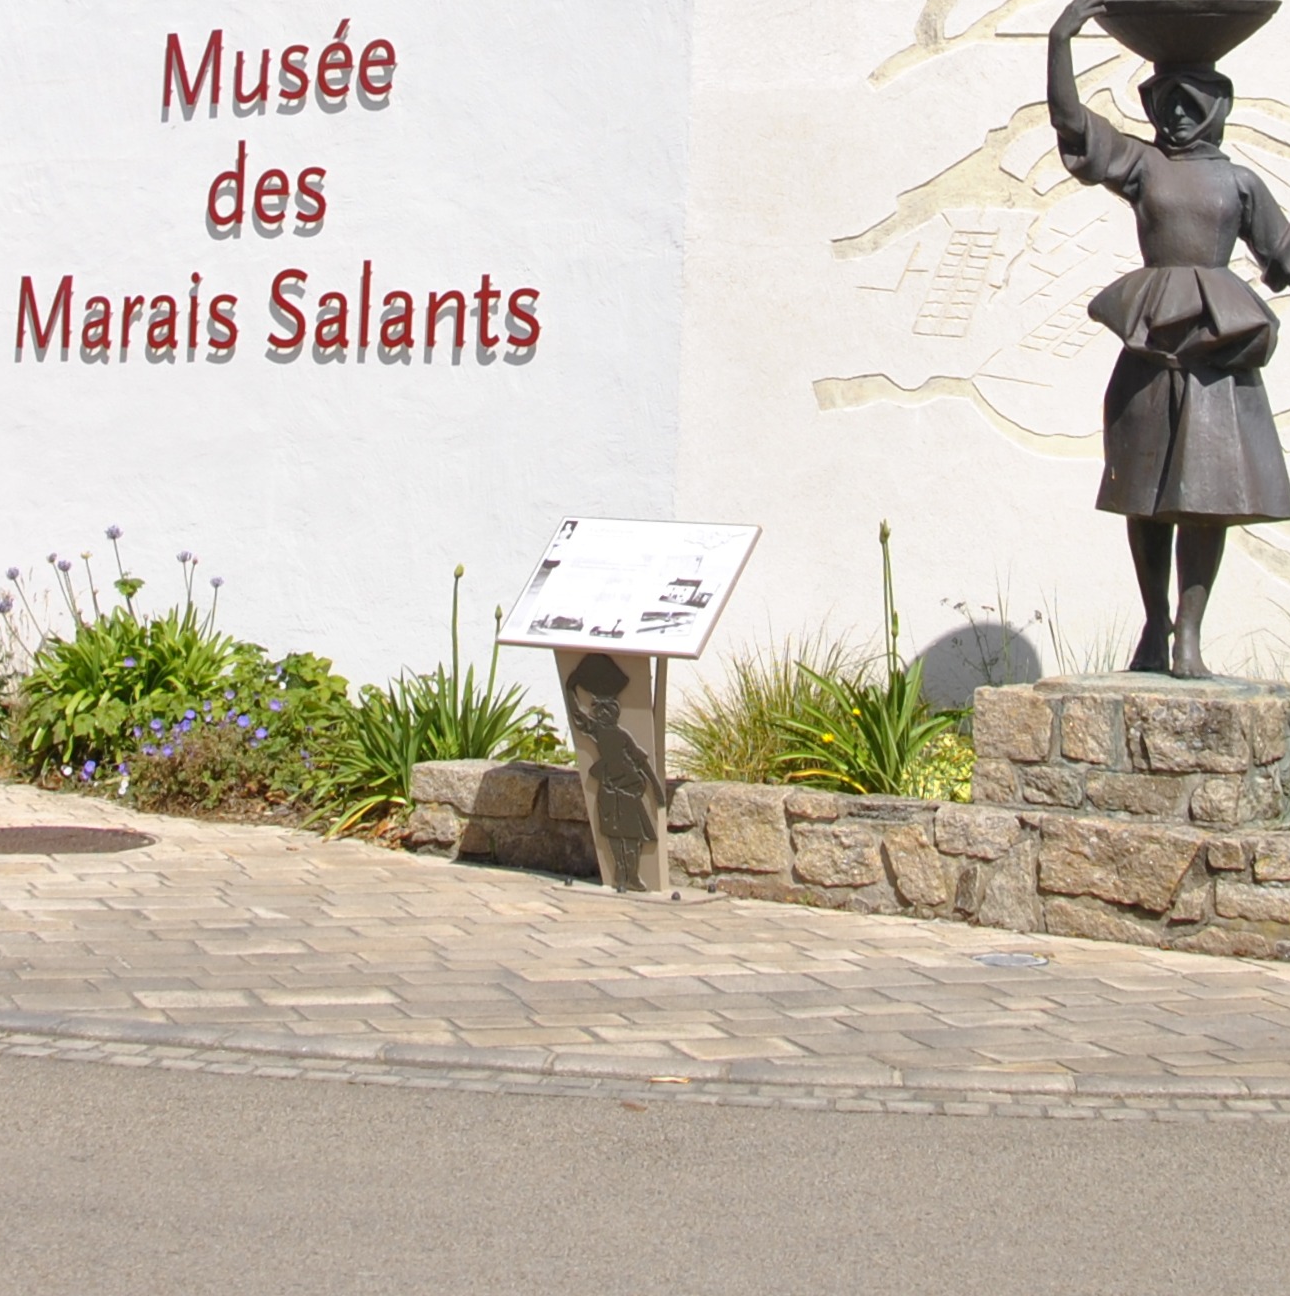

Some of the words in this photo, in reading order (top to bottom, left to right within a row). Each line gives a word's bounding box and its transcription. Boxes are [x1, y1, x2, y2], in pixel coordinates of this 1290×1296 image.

[162, 18, 396, 108] Musée
[207, 139, 328, 227] des
[16, 271, 239, 350] Marais
[266, 259, 541, 350] Salants
